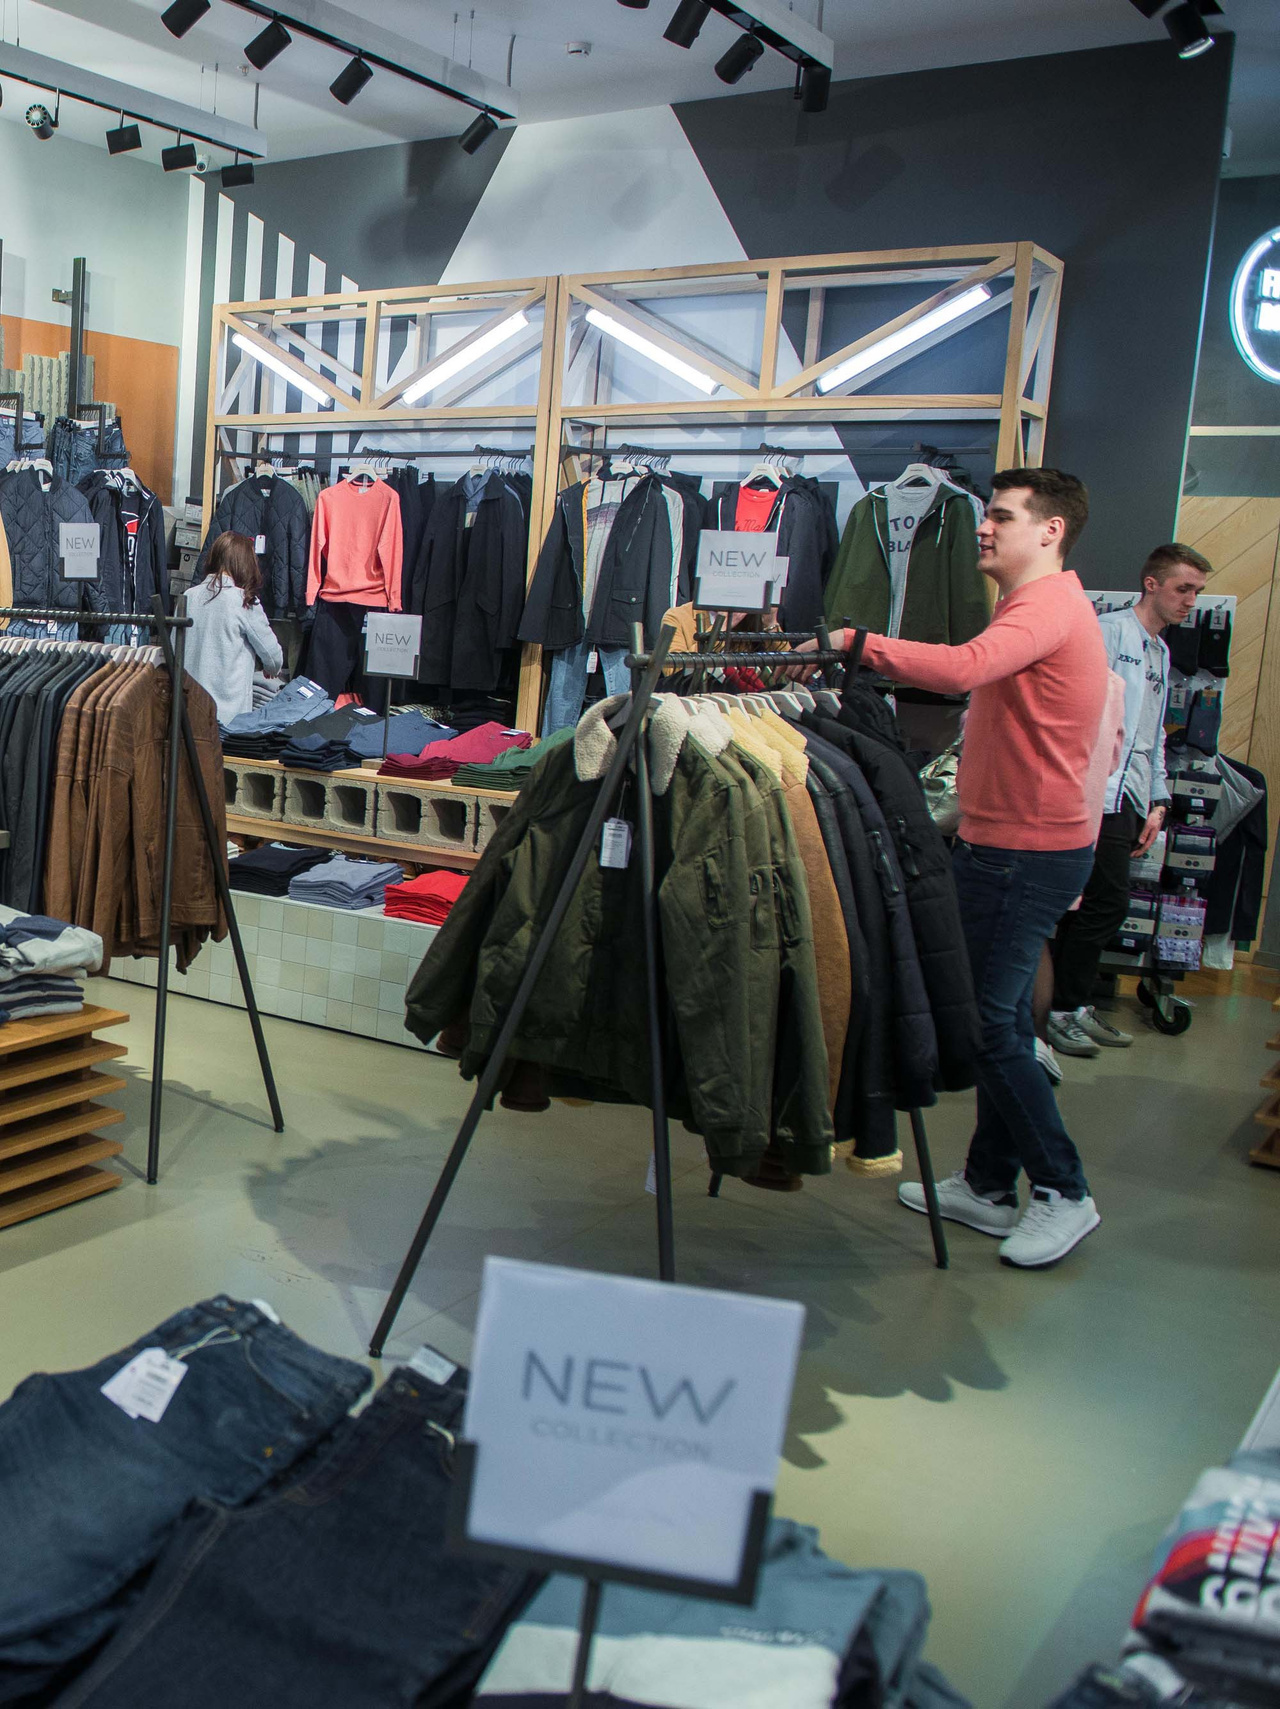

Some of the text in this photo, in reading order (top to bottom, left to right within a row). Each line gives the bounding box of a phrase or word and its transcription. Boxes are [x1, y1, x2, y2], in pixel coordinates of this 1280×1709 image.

[66, 537, 95, 549] NEW
[709, 550, 767, 567] NEW
[712, 570, 760, 578] COLLECTION
[375, 632, 411, 646] NEW
[523, 1350, 738, 1427] NEW
[530, 1416, 712, 1461] COLLECTION
